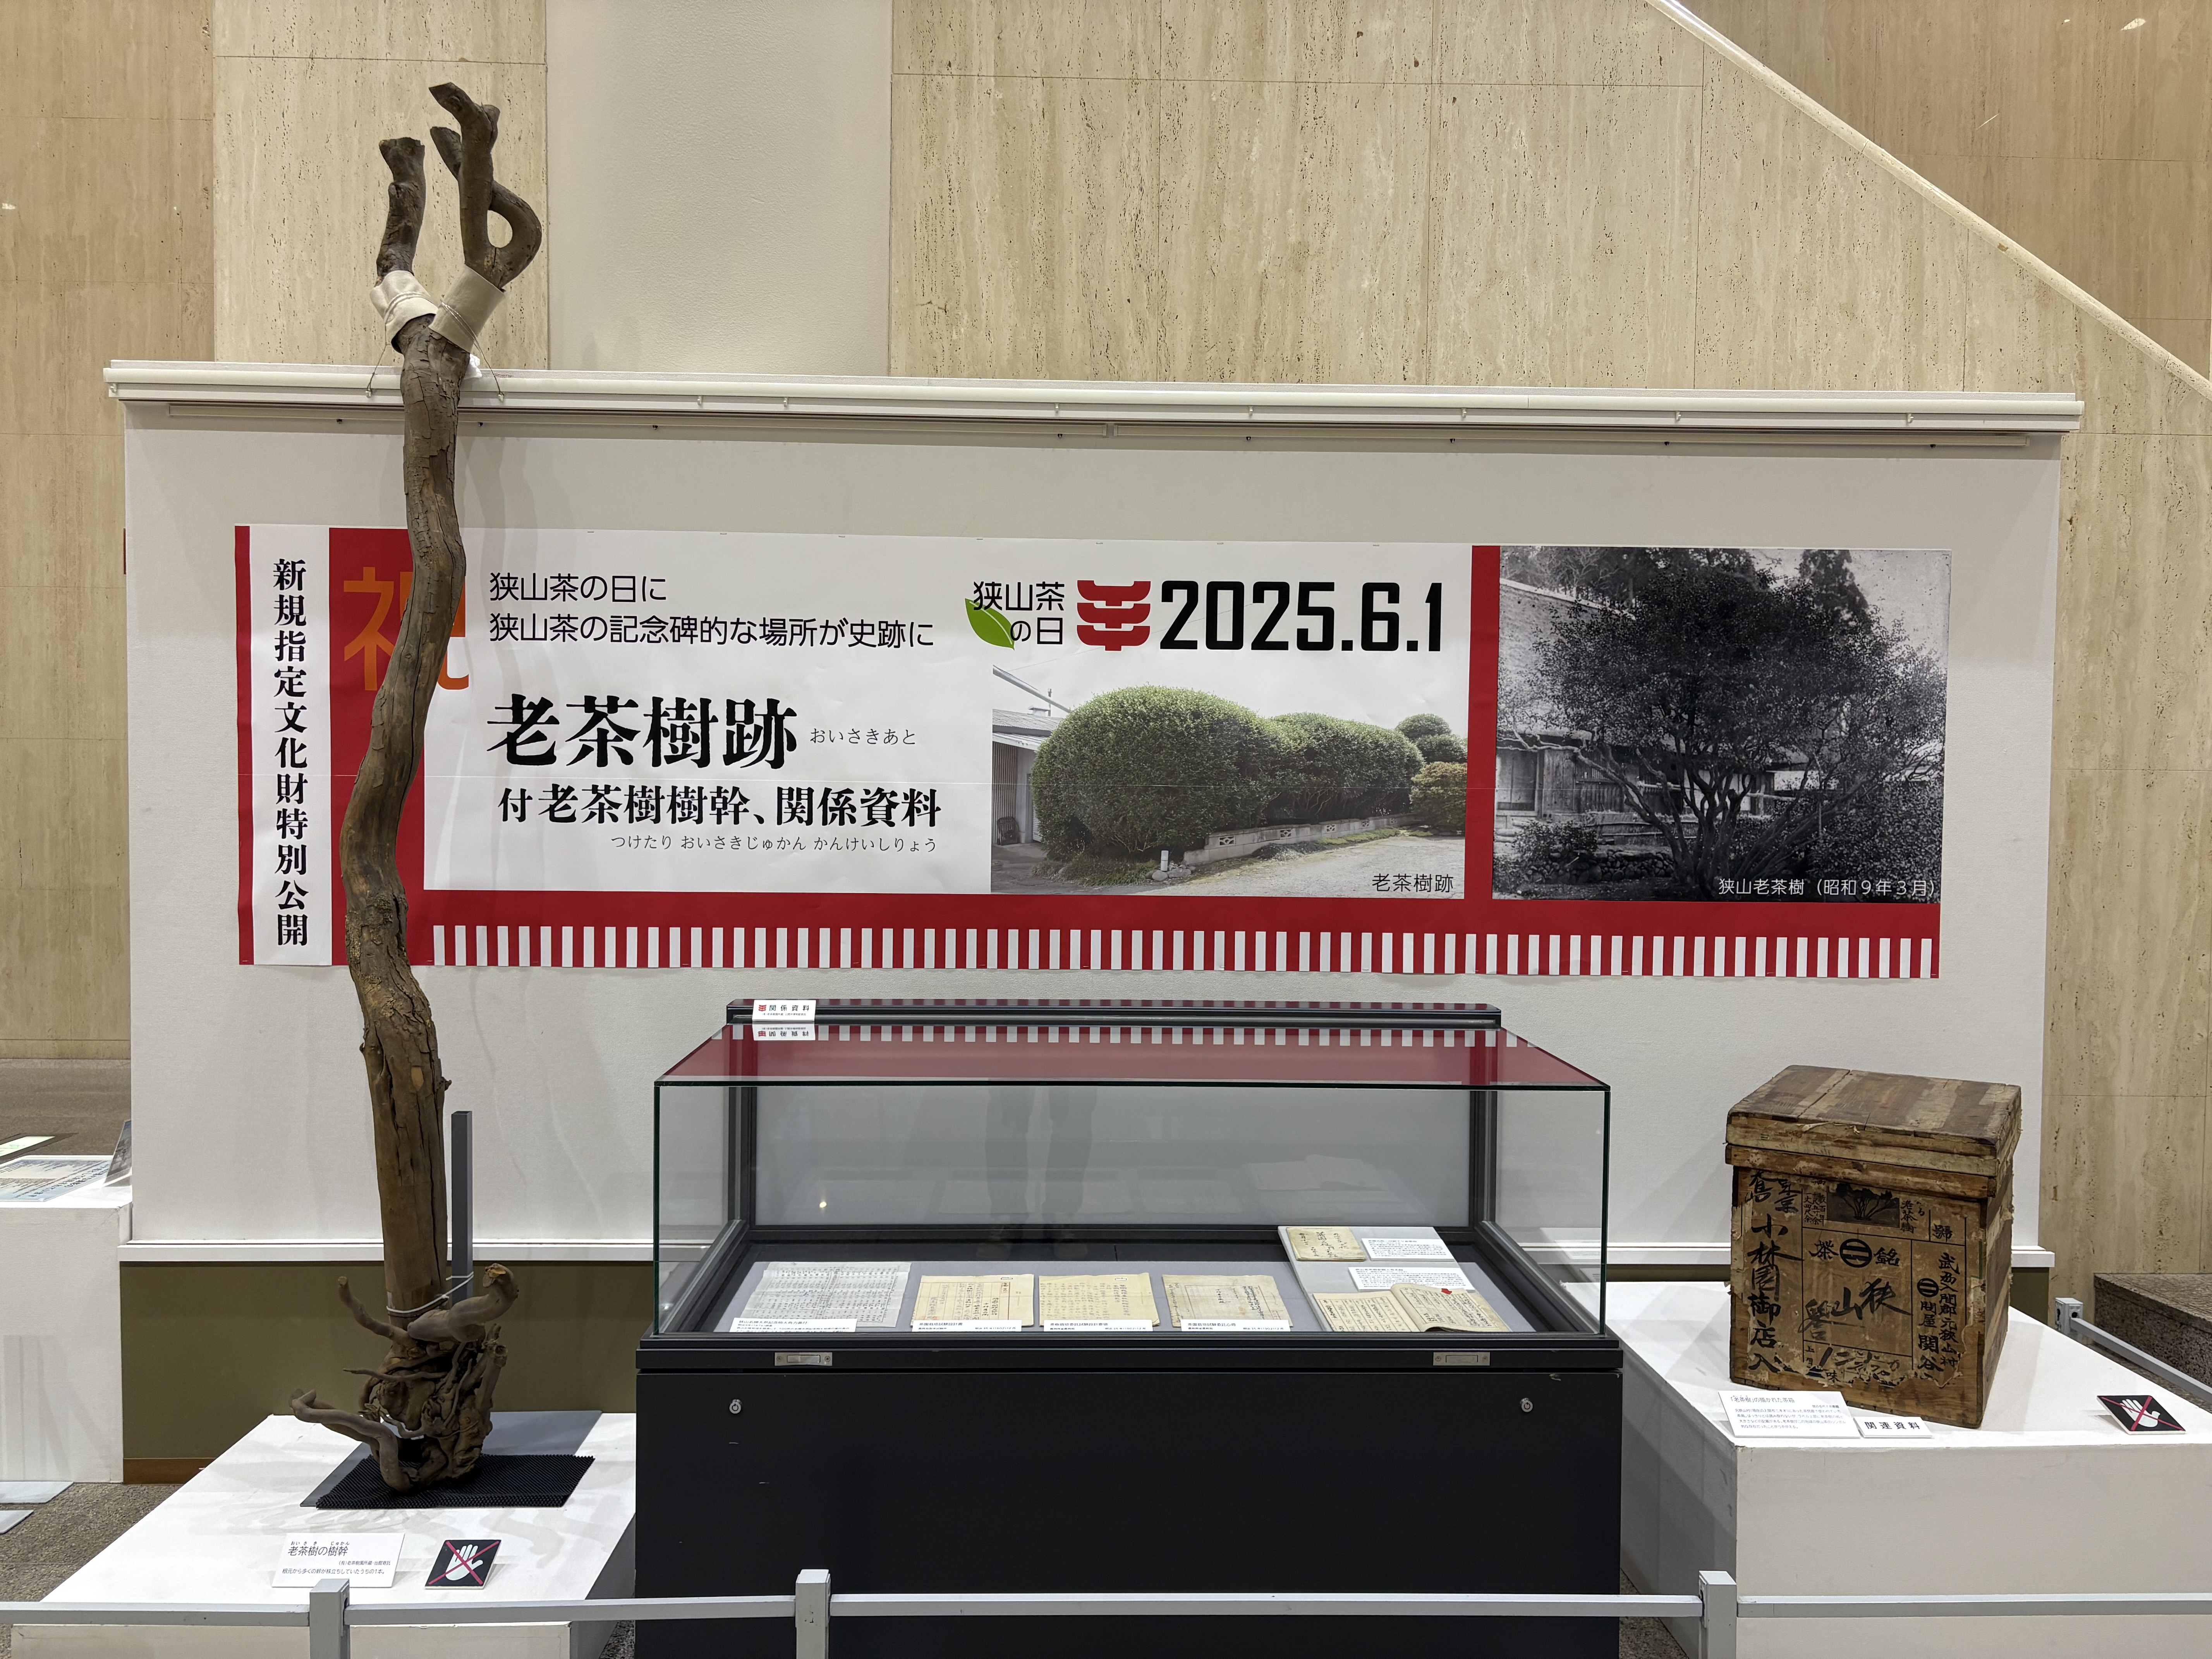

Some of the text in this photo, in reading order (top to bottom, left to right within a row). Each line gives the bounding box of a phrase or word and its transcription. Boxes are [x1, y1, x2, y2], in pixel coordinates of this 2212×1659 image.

[489, 572, 666, 603] 狭山茶の日に
[973, 581, 1065, 611] 狭山茶
[489, 613, 933, 648] 狭山茶の記念碑的な場所が史跡に
[1160, 580, 1442, 652] 2025.6.1
[1010, 617, 1063, 645] の日
[486, 693, 797, 769] 老茶樹跡
[810, 728, 915, 745] おいさきあと
[273, 558, 309, 946] 新規指定文化財特別公開
[611, 835, 935, 852] つけたり おいさきじゅかん かんけいしりょう
[1372, 873, 1454, 893] 老茶樹跡
[1865, 1421, 1920, 1430] 関連資料
[288, 1546, 348, 1556] 老茶樹の樹幹
